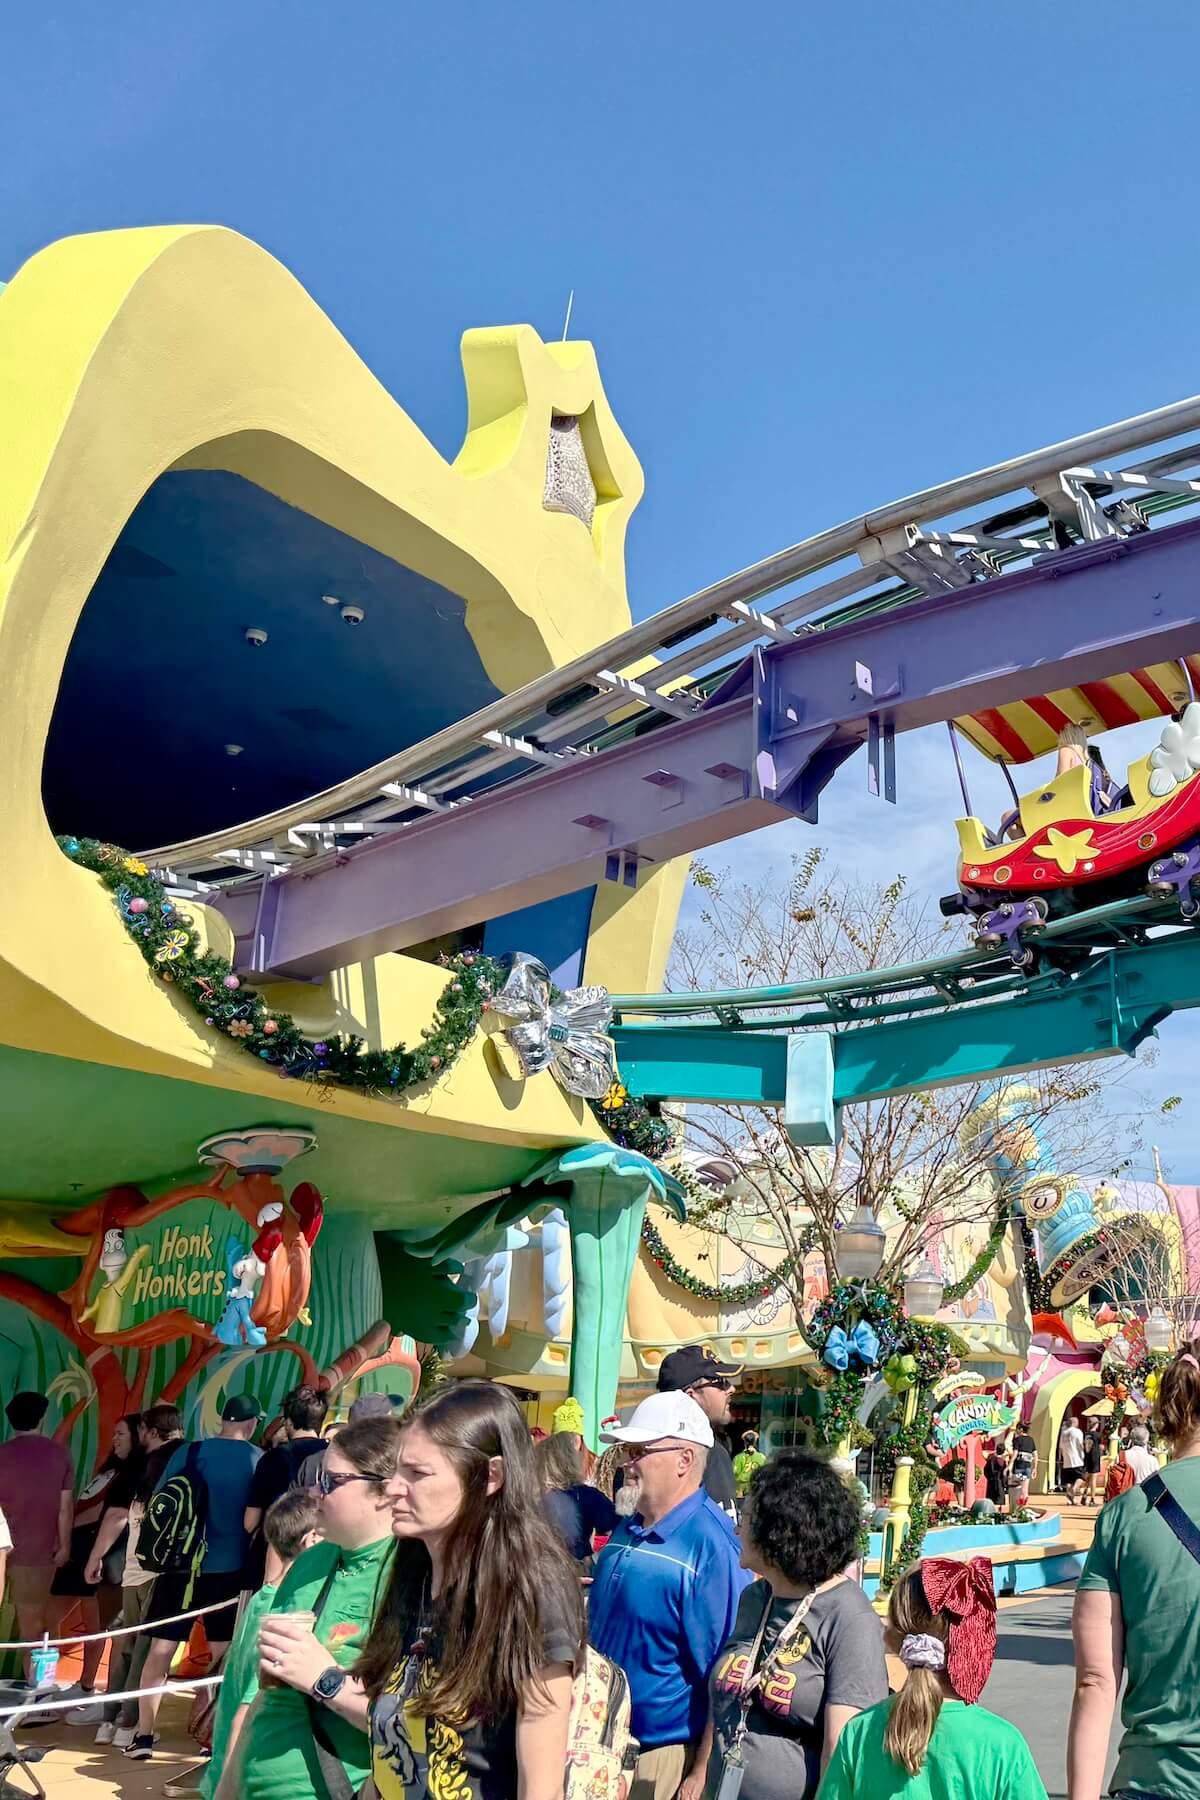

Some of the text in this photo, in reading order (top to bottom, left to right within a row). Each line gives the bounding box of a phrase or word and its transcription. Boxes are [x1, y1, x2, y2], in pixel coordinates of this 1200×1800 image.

[158, 1223, 214, 1265] Honk
[131, 1263, 227, 1306] Honkers
[947, 1400, 1002, 1428] CANDY
[716, 1652, 798, 1706] 192
